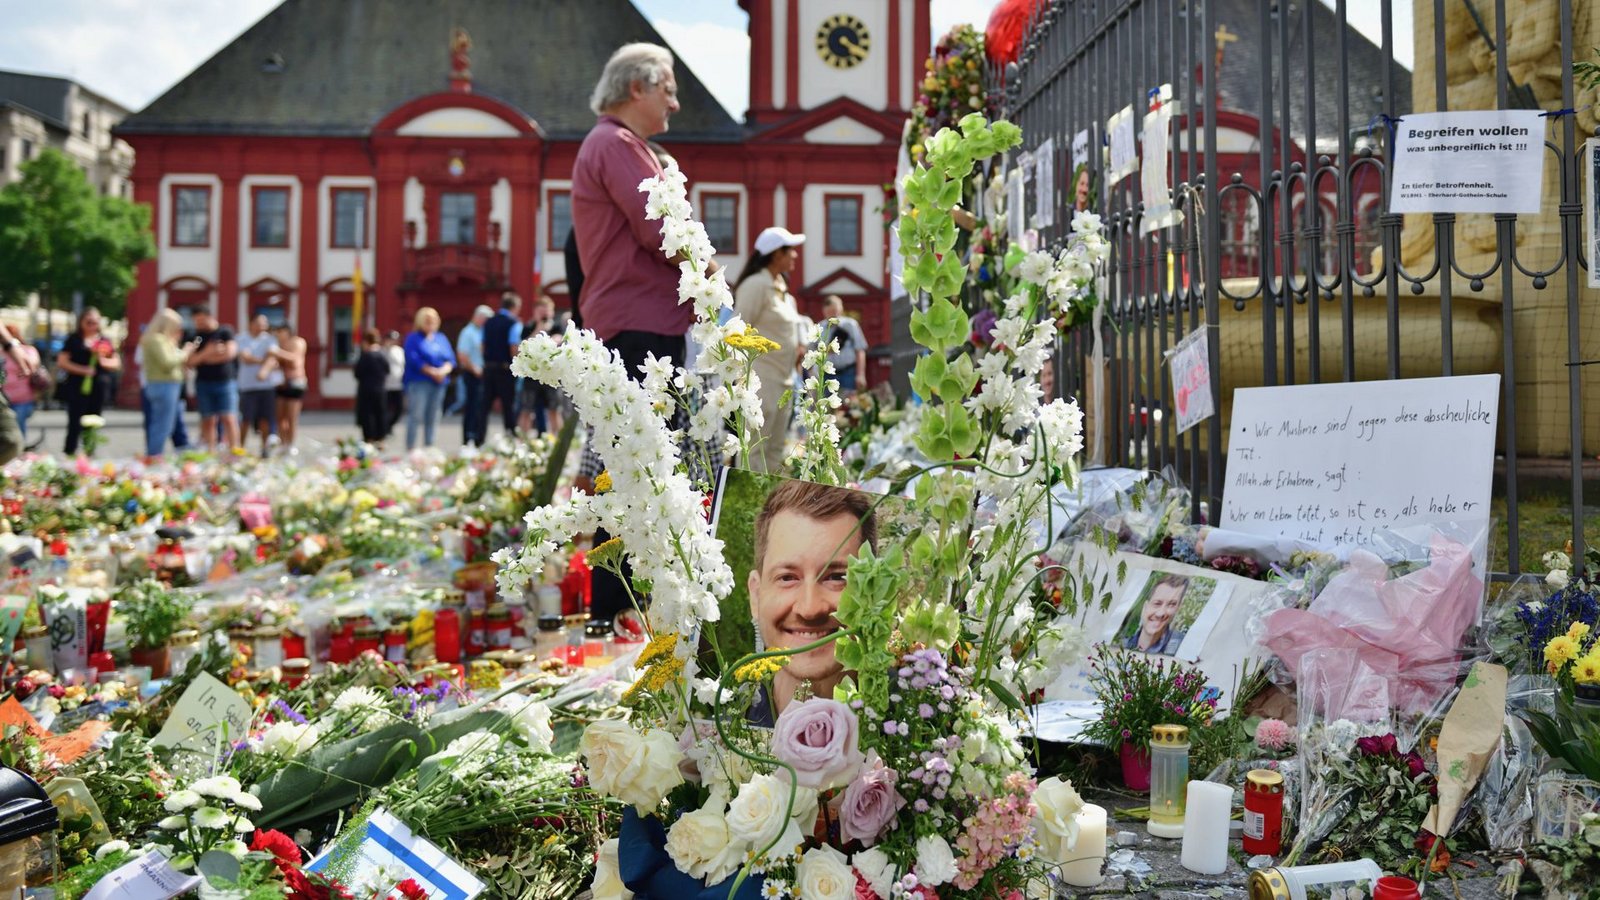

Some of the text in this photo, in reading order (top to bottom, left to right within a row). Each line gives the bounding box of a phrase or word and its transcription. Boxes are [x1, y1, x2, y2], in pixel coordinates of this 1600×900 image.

[1408, 125, 1529, 140] Begreifen wollen
[1428, 142, 1496, 153] unbegreiflich
[1499, 142, 1513, 151] ist
[1515, 143, 1528, 151] !!!
[1412, 181, 1434, 190] tiefer
[1435, 181, 1494, 189] Betroffenheit.
[1255, 420, 1272, 438] Wir
[1324, 405, 1352, 434] sind
[1356, 417, 1386, 441] gegen
[1395, 405, 1418, 423] diese
[1424, 399, 1490, 424] abscheuliche
[1269, 505, 1292, 521] Leben
[1329, 507, 1339, 519] so
[1347, 500, 1366, 521] ist
[1429, 494, 1456, 513] habe
[1463, 501, 1479, 512] er
[198, 686, 217, 710] In
[186, 717, 202, 733] an
